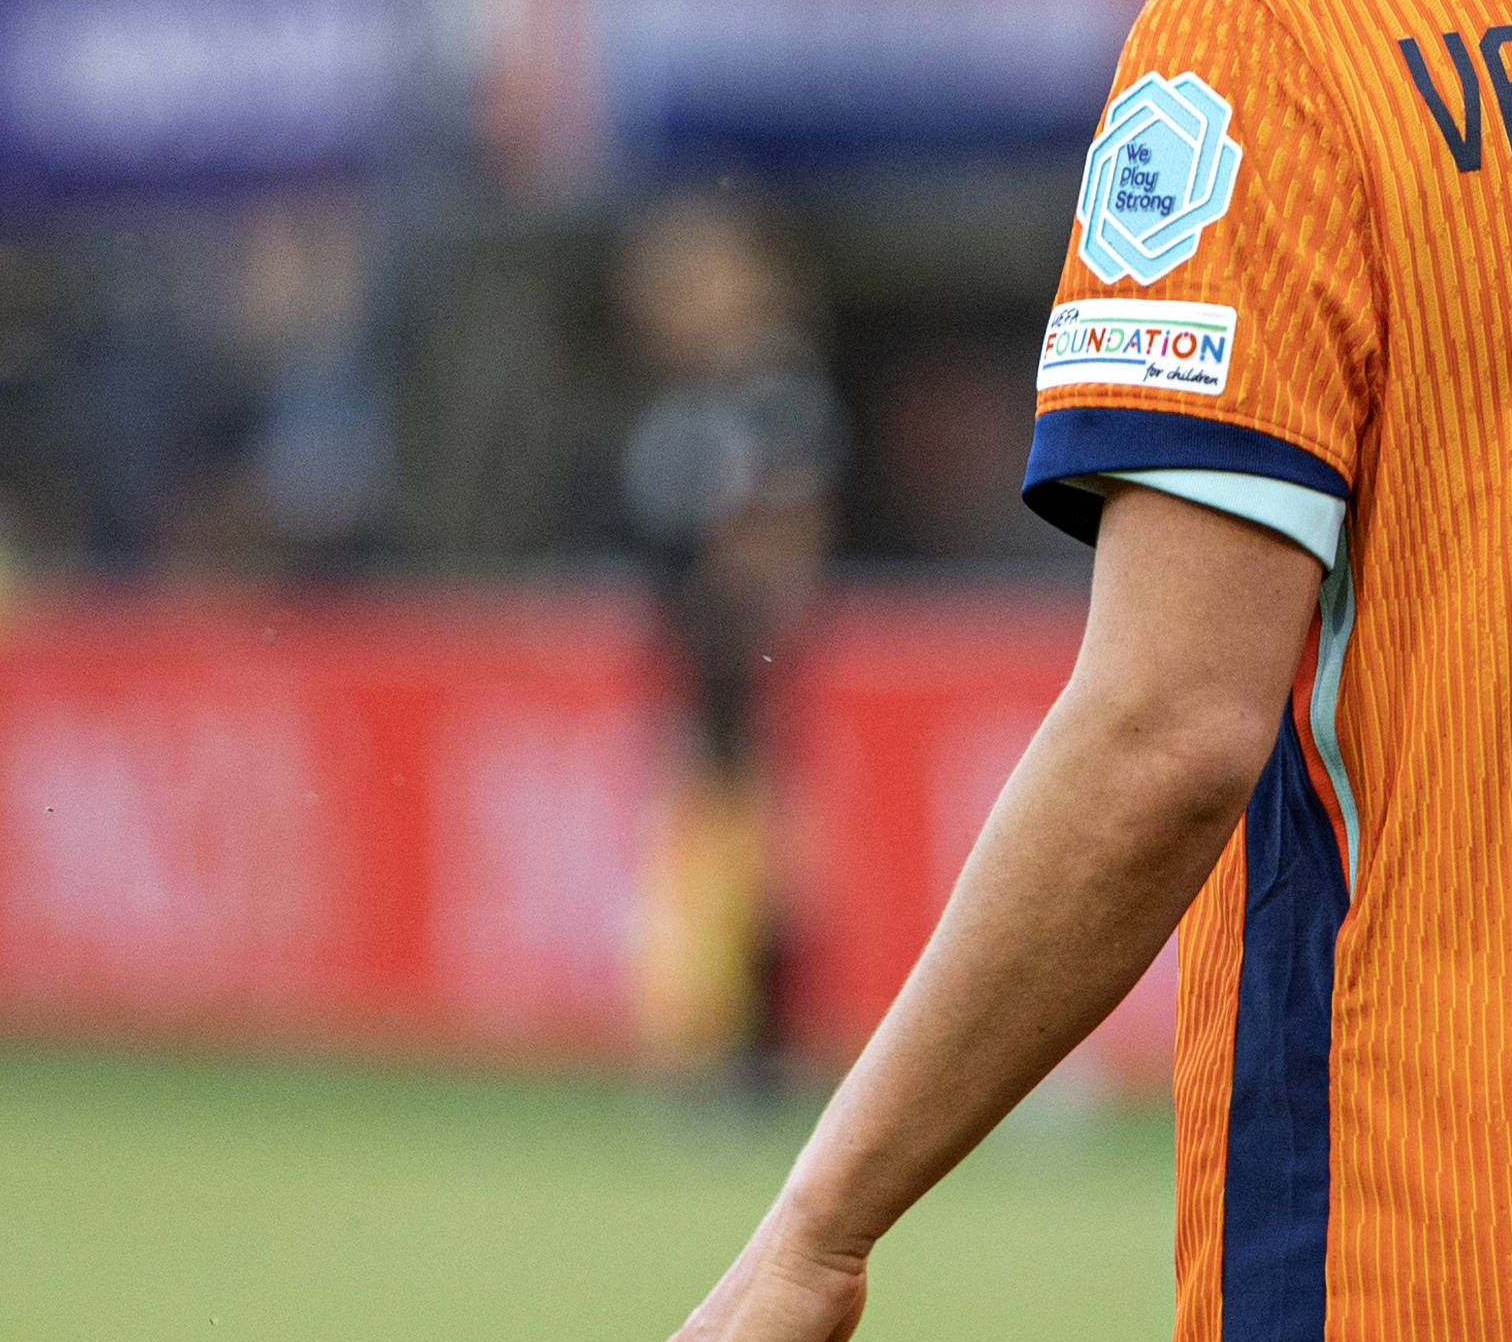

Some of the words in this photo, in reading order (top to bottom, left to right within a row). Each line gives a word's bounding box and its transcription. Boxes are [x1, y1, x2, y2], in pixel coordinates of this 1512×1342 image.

[1126, 143, 1150, 163] We
[1119, 167, 1158, 192] Play
[1115, 190, 1175, 216] Strong
[1050, 308, 1080, 328] UEFA
[1142, 362, 1162, 382] for
[1166, 366, 1219, 386] children
